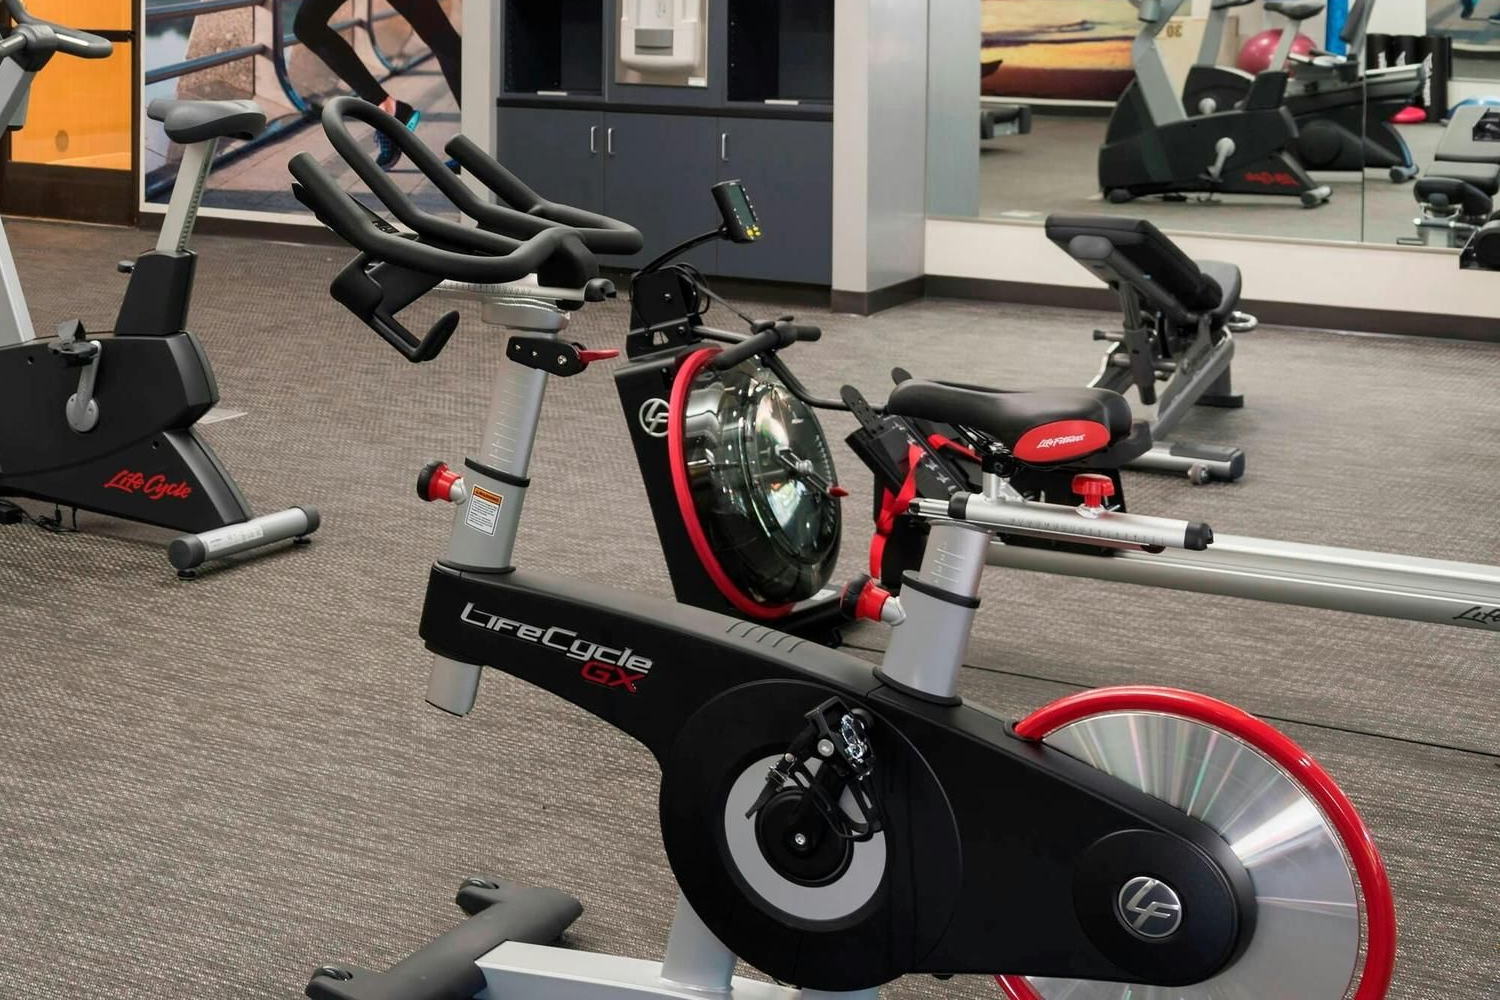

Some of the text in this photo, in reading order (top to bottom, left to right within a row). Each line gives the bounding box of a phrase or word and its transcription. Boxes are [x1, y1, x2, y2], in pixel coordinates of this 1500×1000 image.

[103, 469, 194, 500] Life Cycle
[580, 660, 647, 694] GX
